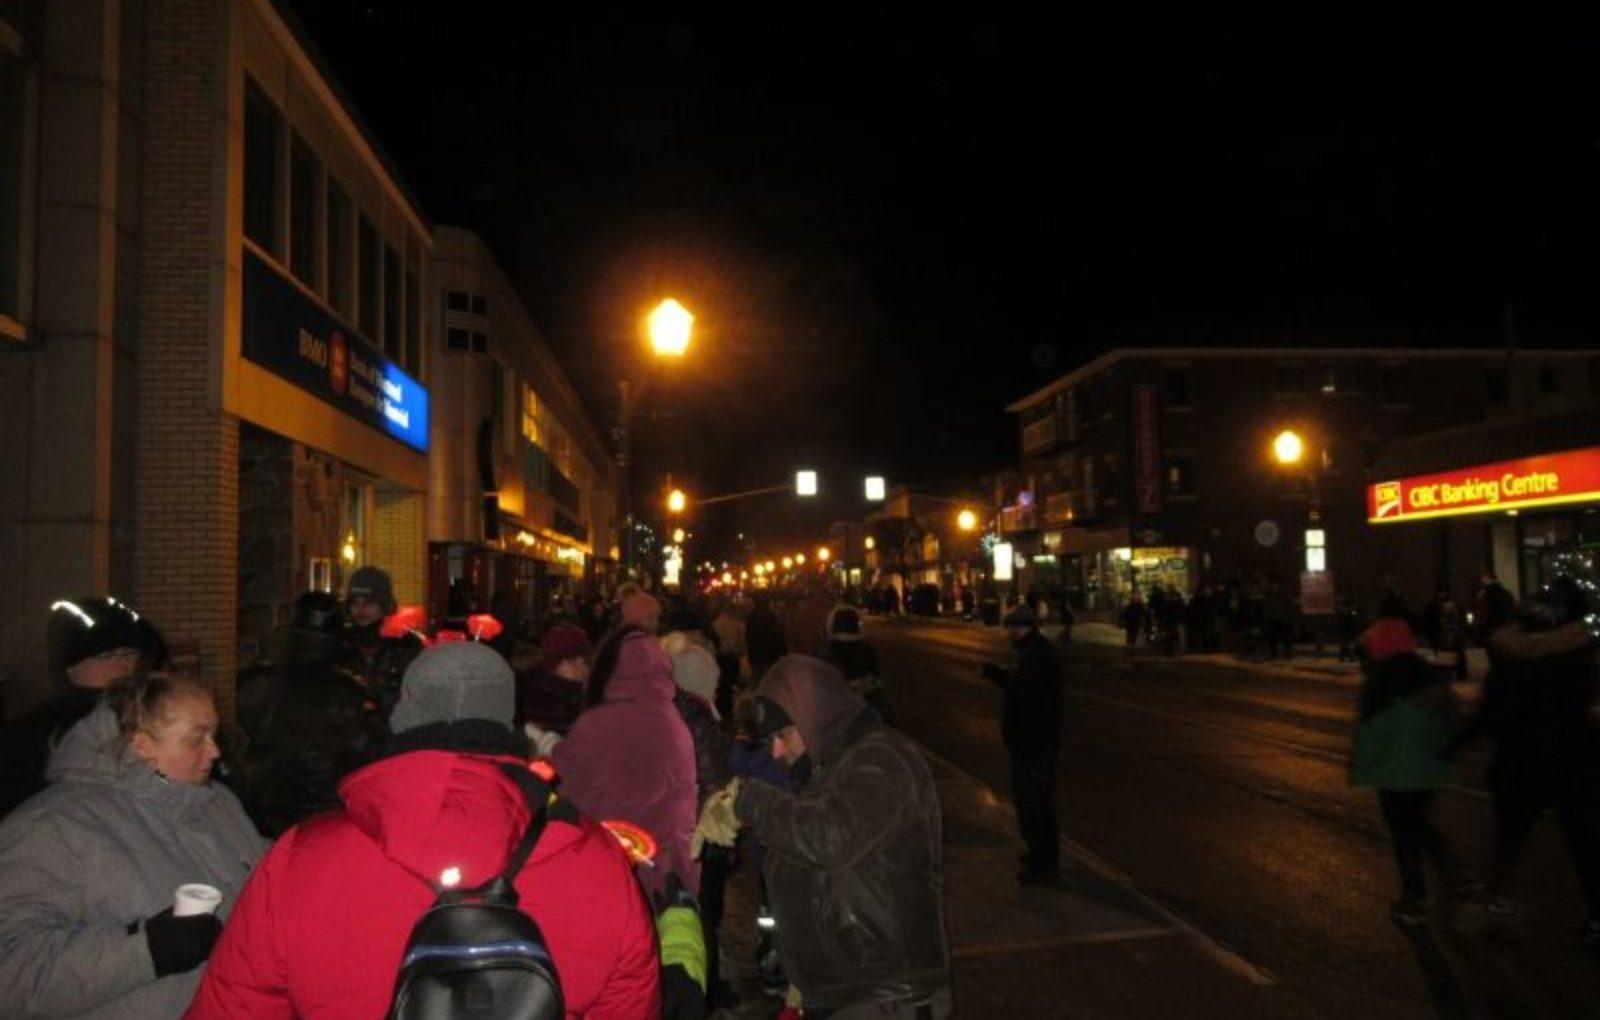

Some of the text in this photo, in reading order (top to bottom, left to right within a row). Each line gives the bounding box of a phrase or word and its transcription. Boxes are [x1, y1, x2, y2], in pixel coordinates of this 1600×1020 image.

[1409, 472, 1558, 507] CIBC Banking Centre
